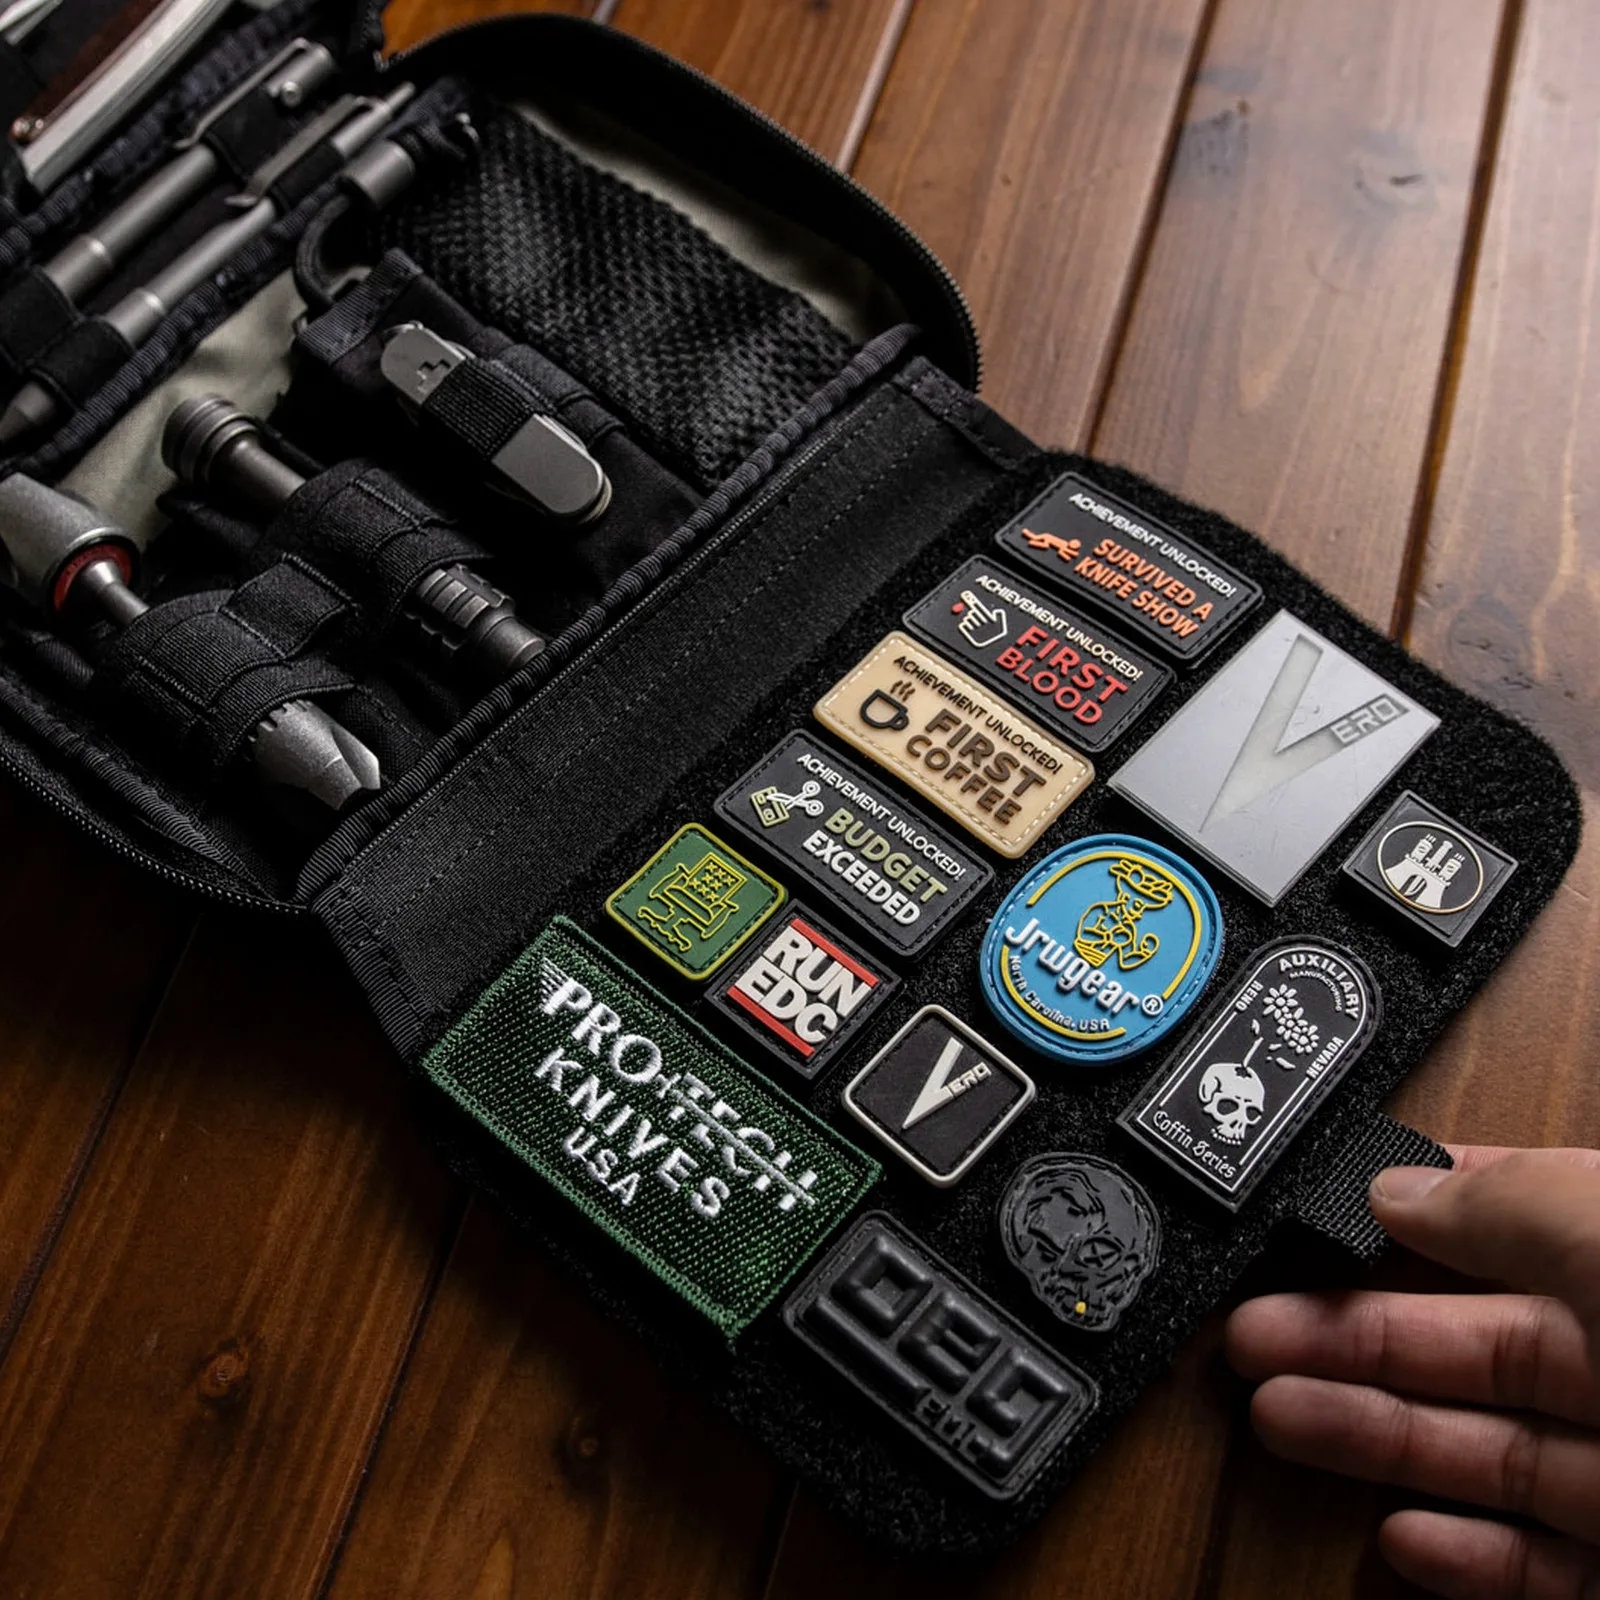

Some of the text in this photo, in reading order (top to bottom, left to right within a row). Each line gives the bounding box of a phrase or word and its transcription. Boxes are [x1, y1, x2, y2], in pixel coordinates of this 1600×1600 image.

[1070, 493, 1237, 598] ACHIEVEMENT UNLOCKED!
[1094, 538, 1213, 622] SURVIVED A
[976, 575, 1144, 682] ACHIEVEMENT UNLOCKED!
[1074, 556, 1199, 639] KNIFE SHOW
[995, 647, 1103, 725] BLOOD
[1015, 625, 1128, 703] FIRST
[894, 655, 1063, 775] ACHIEVEMENT UNLOCKED!
[925, 709, 1047, 798] FIRST
[797, 753, 966, 881] ACHIEVEMENT UNLOCKED!
[907, 735, 1022, 825] COFFEE
[803, 830, 920, 925] EXCEEDED
[825, 808, 948, 902] BUDGET
[734, 956, 837, 1043] EDC
[764, 925, 872, 1018] RUN
[1009, 955, 1028, 992] North
[1080, 1018, 1110, 1031] USA
[1235, 980, 1264, 1012] RENO
[1278, 953, 1360, 1019] AUXILIARY
[1289, 970, 1343, 1013] MANUFACTURING
[1306, 1036, 1345, 1080] NEVADA
[534, 1048, 730, 1218] KNIVES
[563, 1126, 641, 1206] USA
[1153, 1110, 1237, 1179] Coffin Series
